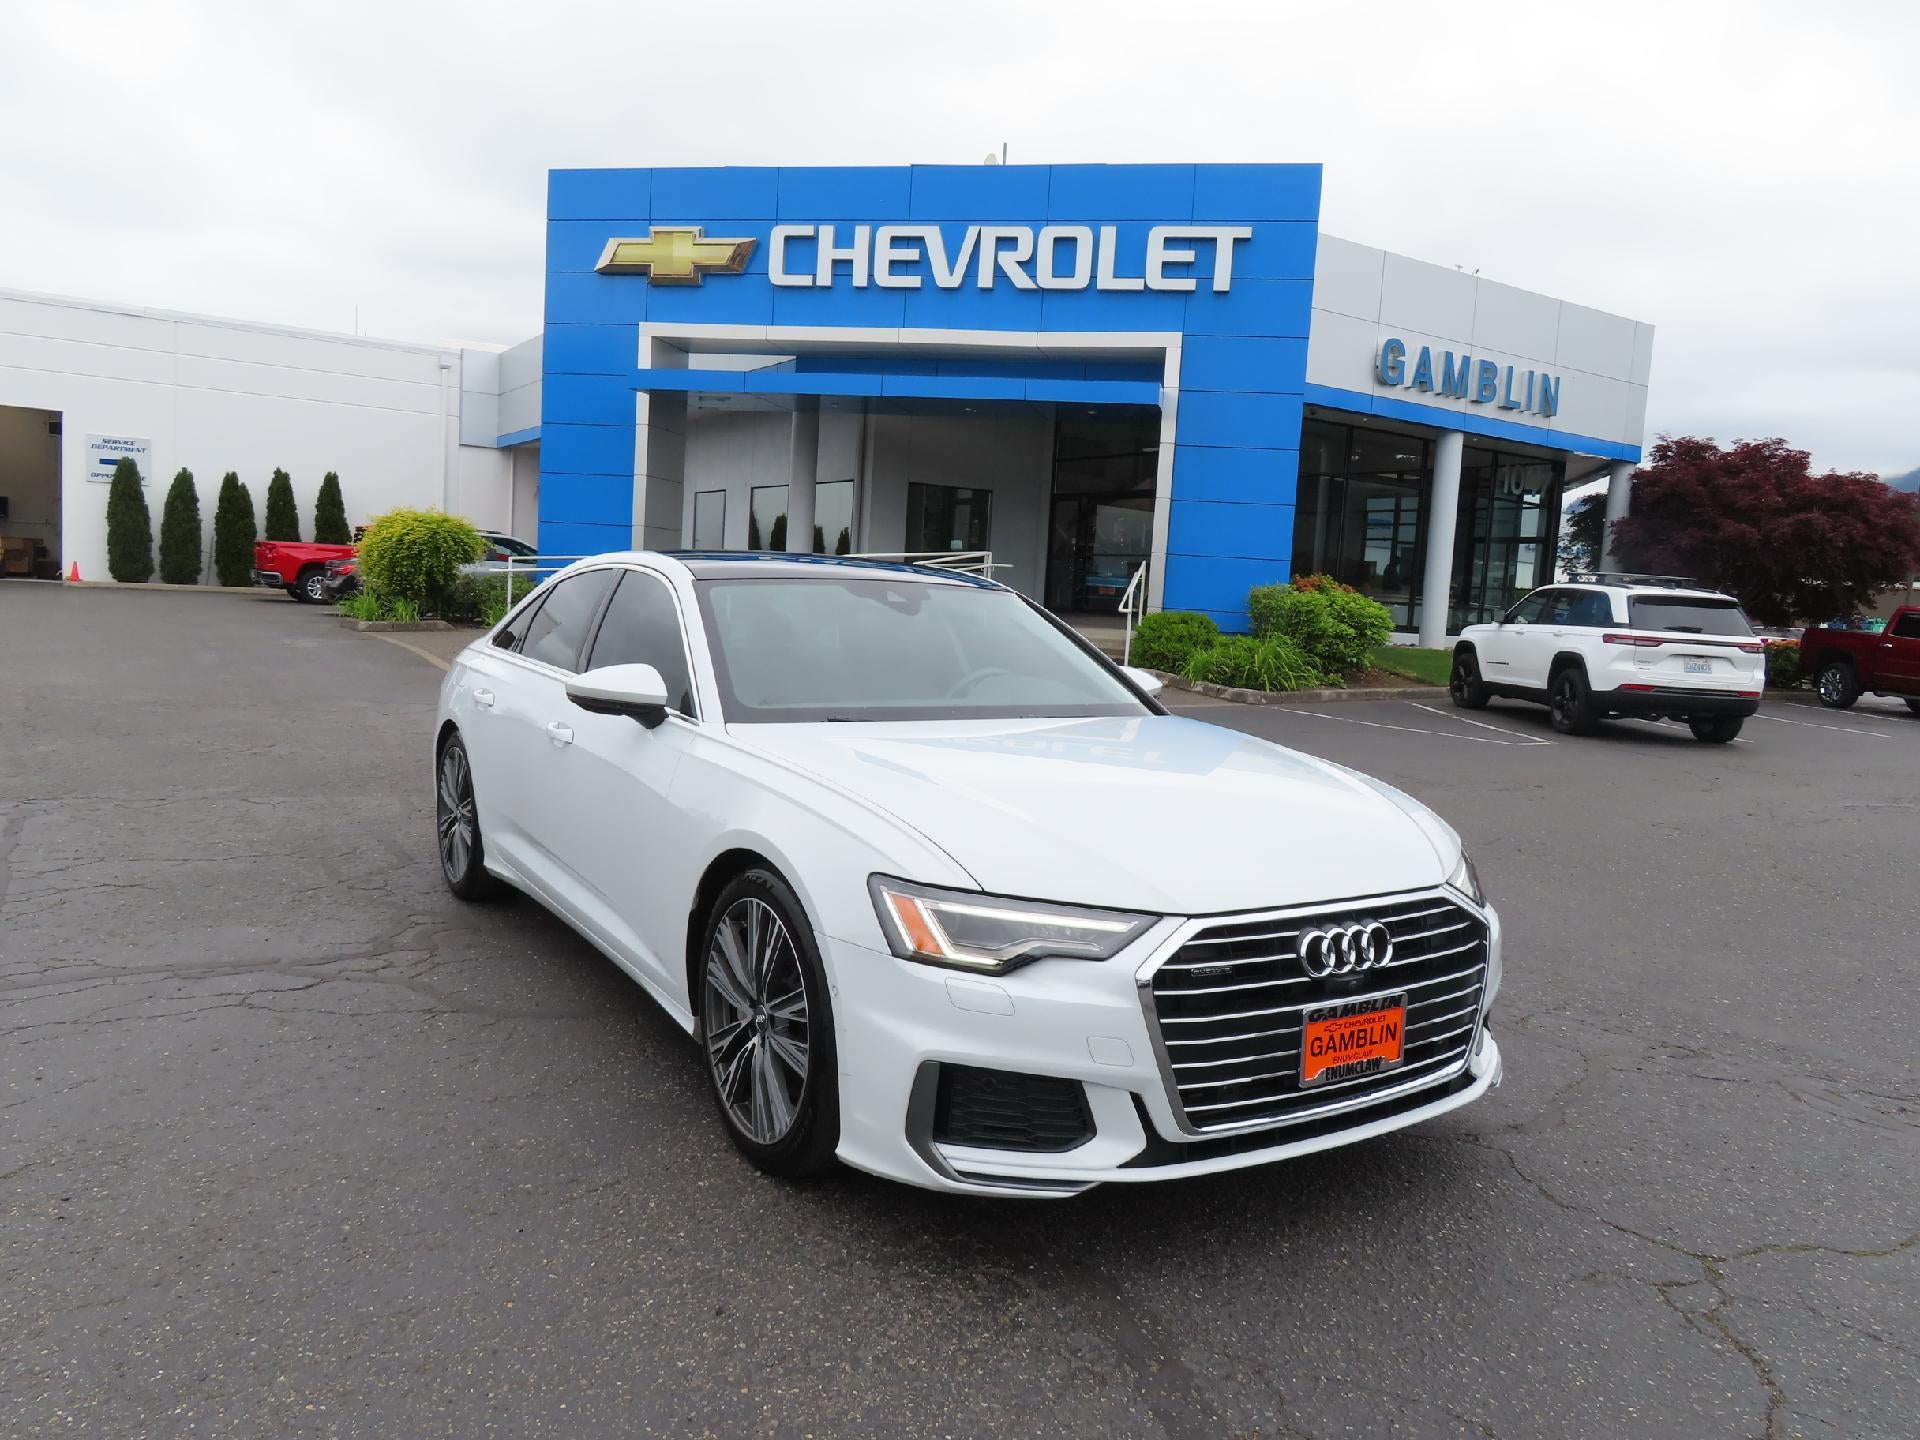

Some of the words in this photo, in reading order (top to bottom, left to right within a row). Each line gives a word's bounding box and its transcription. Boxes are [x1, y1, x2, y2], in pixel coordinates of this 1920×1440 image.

[767, 224, 1253, 293] CHEVROLET
[1376, 337, 1561, 419] GAMBLIN
[91, 443, 147, 453] DEPARTMENT
[1308, 995, 1402, 1023] GAMBLIN
[1343, 1015, 1387, 1029] CHEVROLET
[1310, 1022, 1398, 1057] GAMBLIN
[1325, 1057, 1381, 1080] ENUMCLAW
[1332, 1049, 1373, 1064] ENUMCLAW
